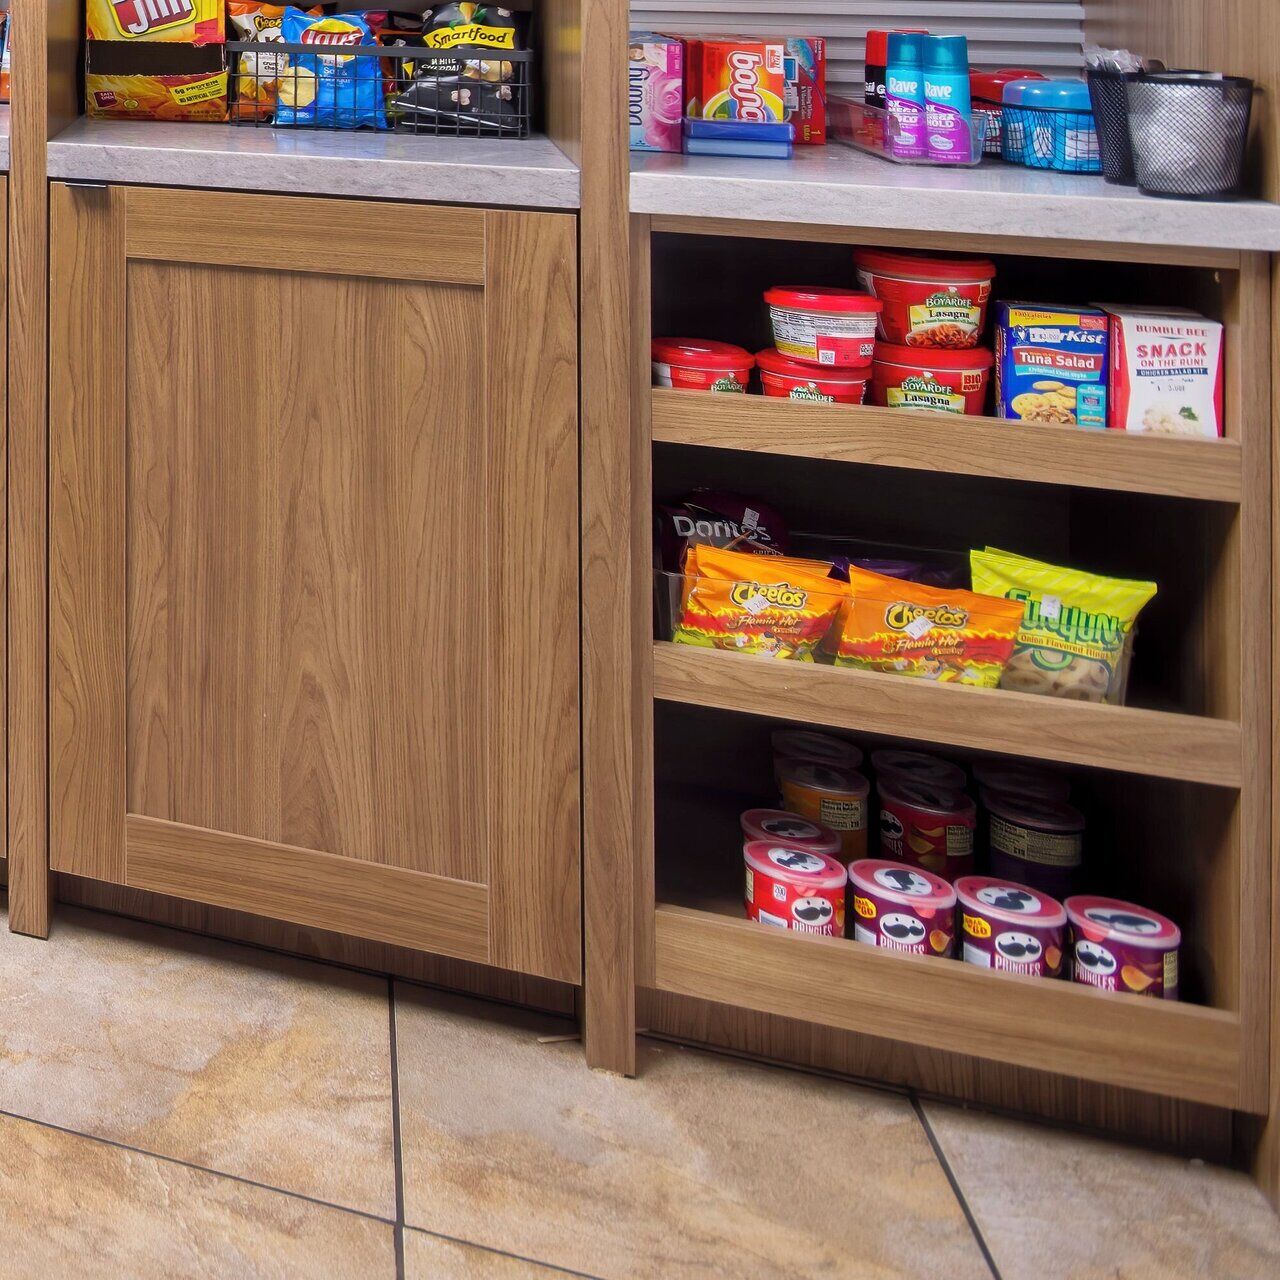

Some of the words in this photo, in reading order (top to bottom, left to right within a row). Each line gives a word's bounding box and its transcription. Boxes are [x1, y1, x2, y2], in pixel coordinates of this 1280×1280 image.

[432, 29, 509, 48] Smartfood
[728, 51, 766, 122] bounc
[889, 77, 918, 94] Rave
[925, 81, 952, 98] Rave
[926, 297, 972, 308] BOYARDEE
[929, 309, 970, 319] Lasagna
[1136, 324, 1184, 336] BUMBLE
[1187, 326, 1208, 337] BEE
[1136, 342, 1207, 359] SNACK
[1020, 352, 1052, 364] Tuna
[1055, 355, 1095, 369] Salad
[1141, 359, 1154, 367] ON
[1157, 358, 1176, 366] THE
[1029, 367, 1056, 375] Original
[901, 381, 952, 395] BOYARDEE
[790, 391, 835, 403] BOYARDEE
[904, 394, 950, 406] Lasagna
[673, 515, 771, 542] Doritos
[731, 583, 807, 608] Cheetos
[738, 616, 777, 626] Flamin'
[779, 616, 802, 626] Hot
[887, 603, 968, 629] Cheetos
[897, 638, 936, 650] Flamin'
[938, 636, 963, 647] Hot
[1045, 638, 1084, 653] Flavored
[994, 955, 1041, 976] PRINGLES
[1074, 962, 1115, 993] PRINGLES
